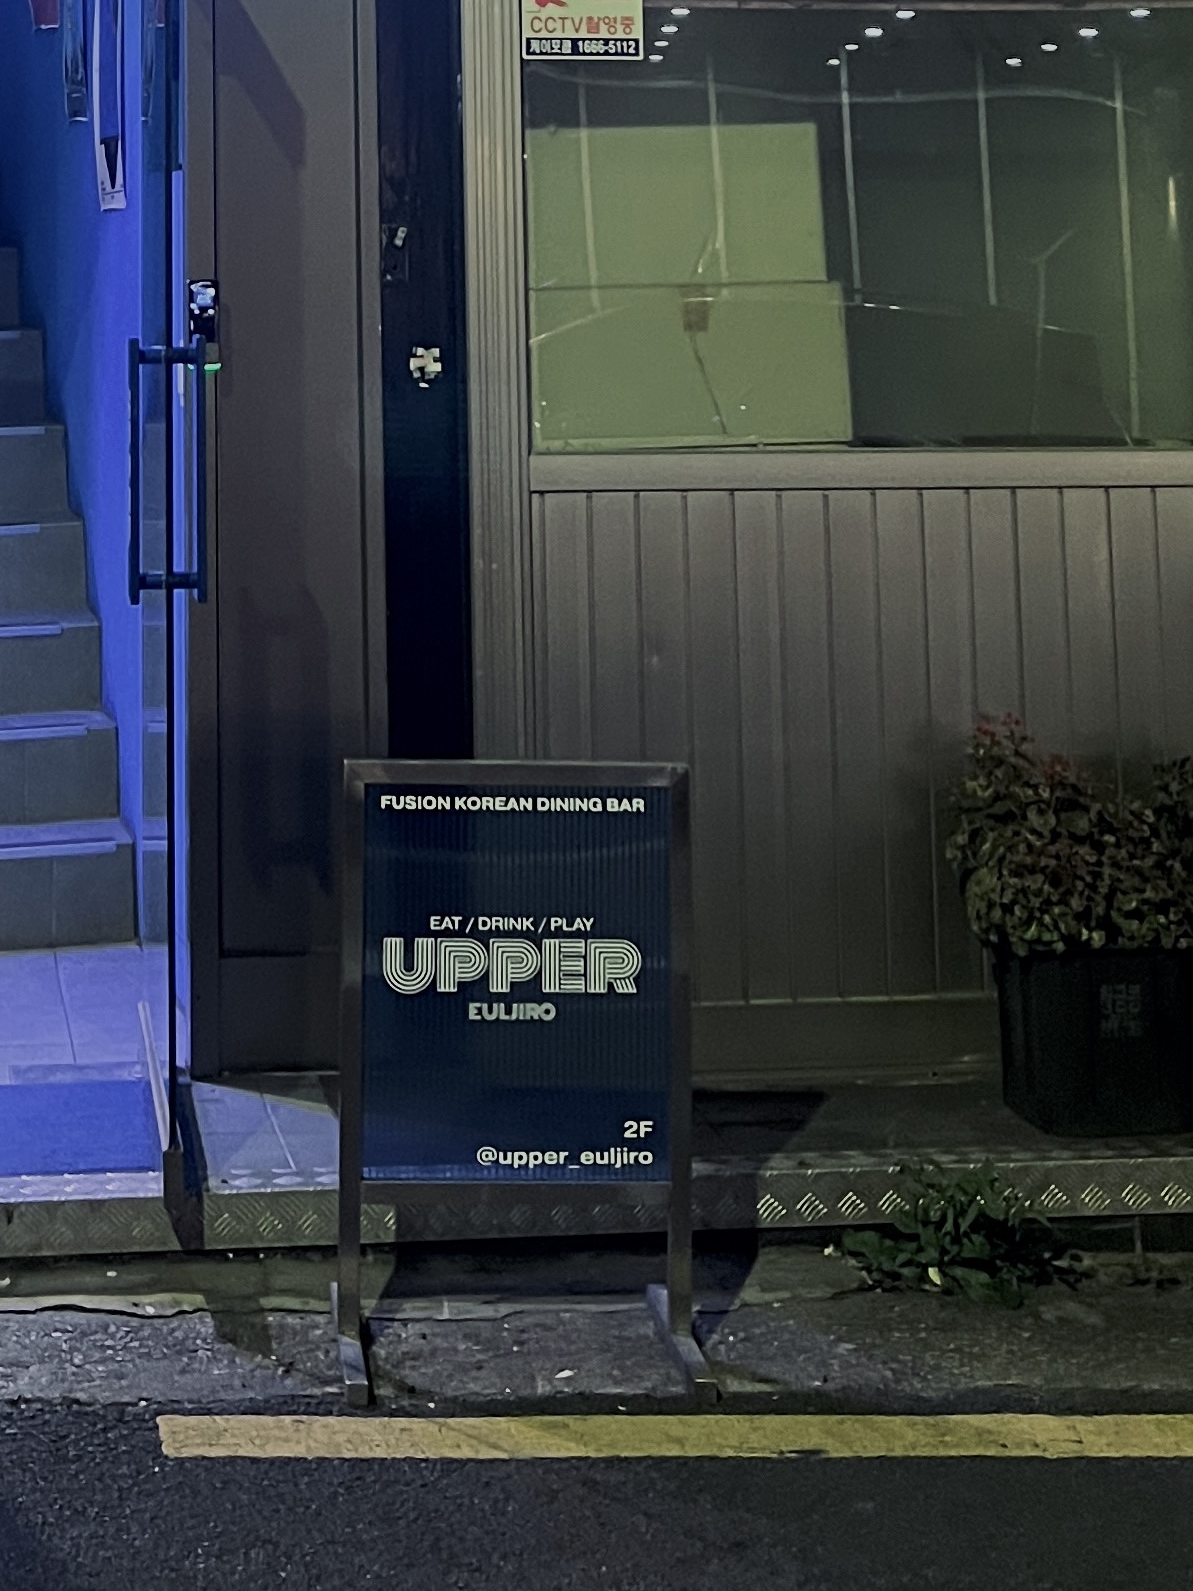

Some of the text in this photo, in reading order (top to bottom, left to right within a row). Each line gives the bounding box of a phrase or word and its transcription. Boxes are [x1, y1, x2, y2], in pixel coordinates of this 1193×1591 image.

[380, 795, 645, 813] FUSION KOREAN DINING BAR
[430, 916, 463, 931] EAT
[478, 916, 535, 932] DRINK
[550, 917, 594, 932] PLAY
[382, 937, 642, 995] UPPER
[468, 1002, 557, 1021] EULJIRO
[623, 1120, 654, 1138] 2F
[476, 1146, 654, 1169] @upper_euljiro
